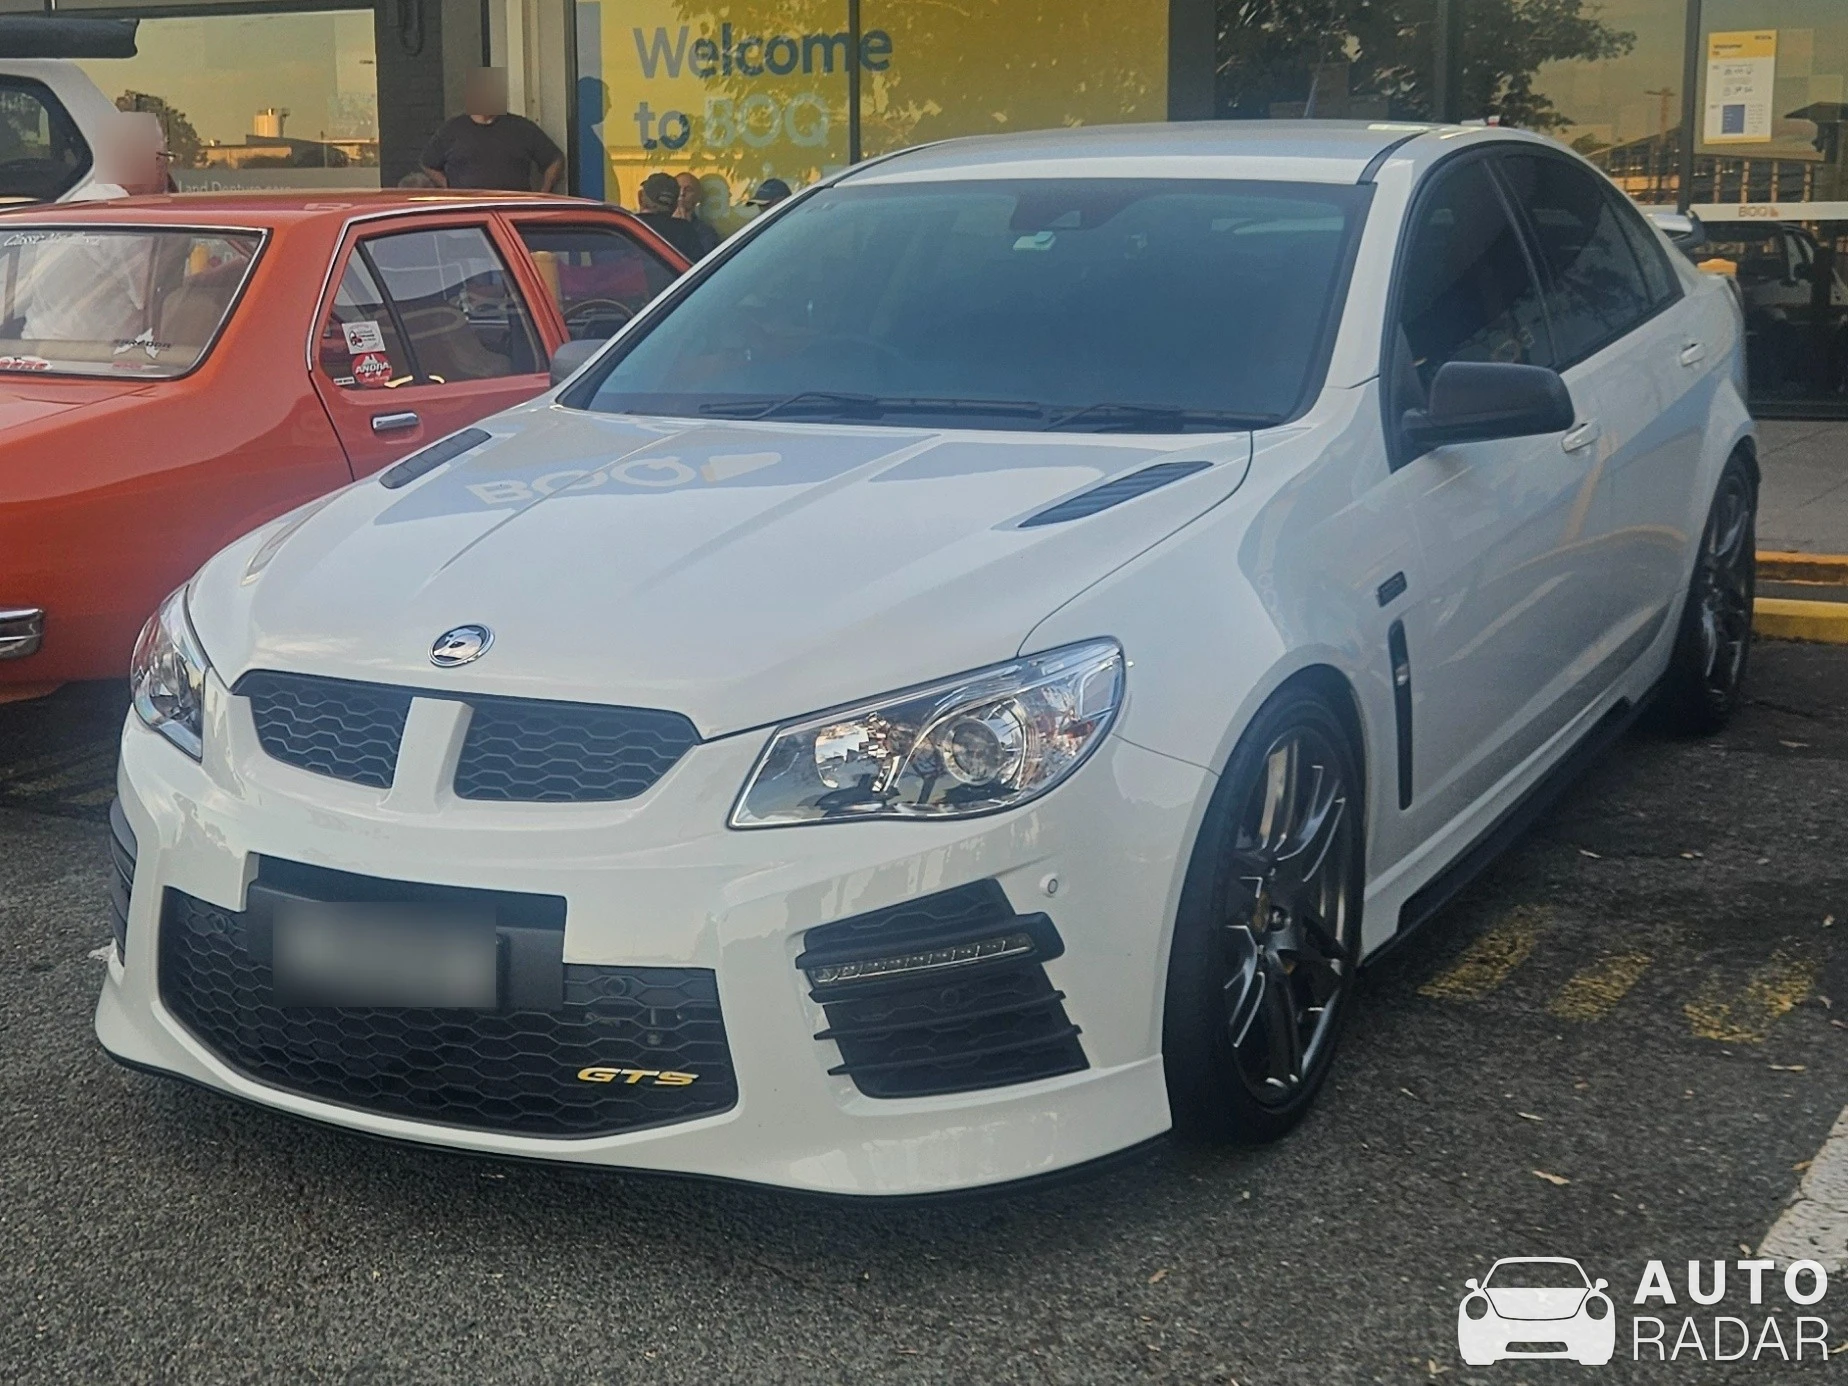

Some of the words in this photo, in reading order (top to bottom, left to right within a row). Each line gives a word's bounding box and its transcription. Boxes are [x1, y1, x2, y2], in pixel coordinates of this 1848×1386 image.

[633, 22, 893, 80] Welcome
[633, 101, 691, 150] to
[703, 93, 830, 148] BOQ
[577, 1066, 700, 1086] GTS
